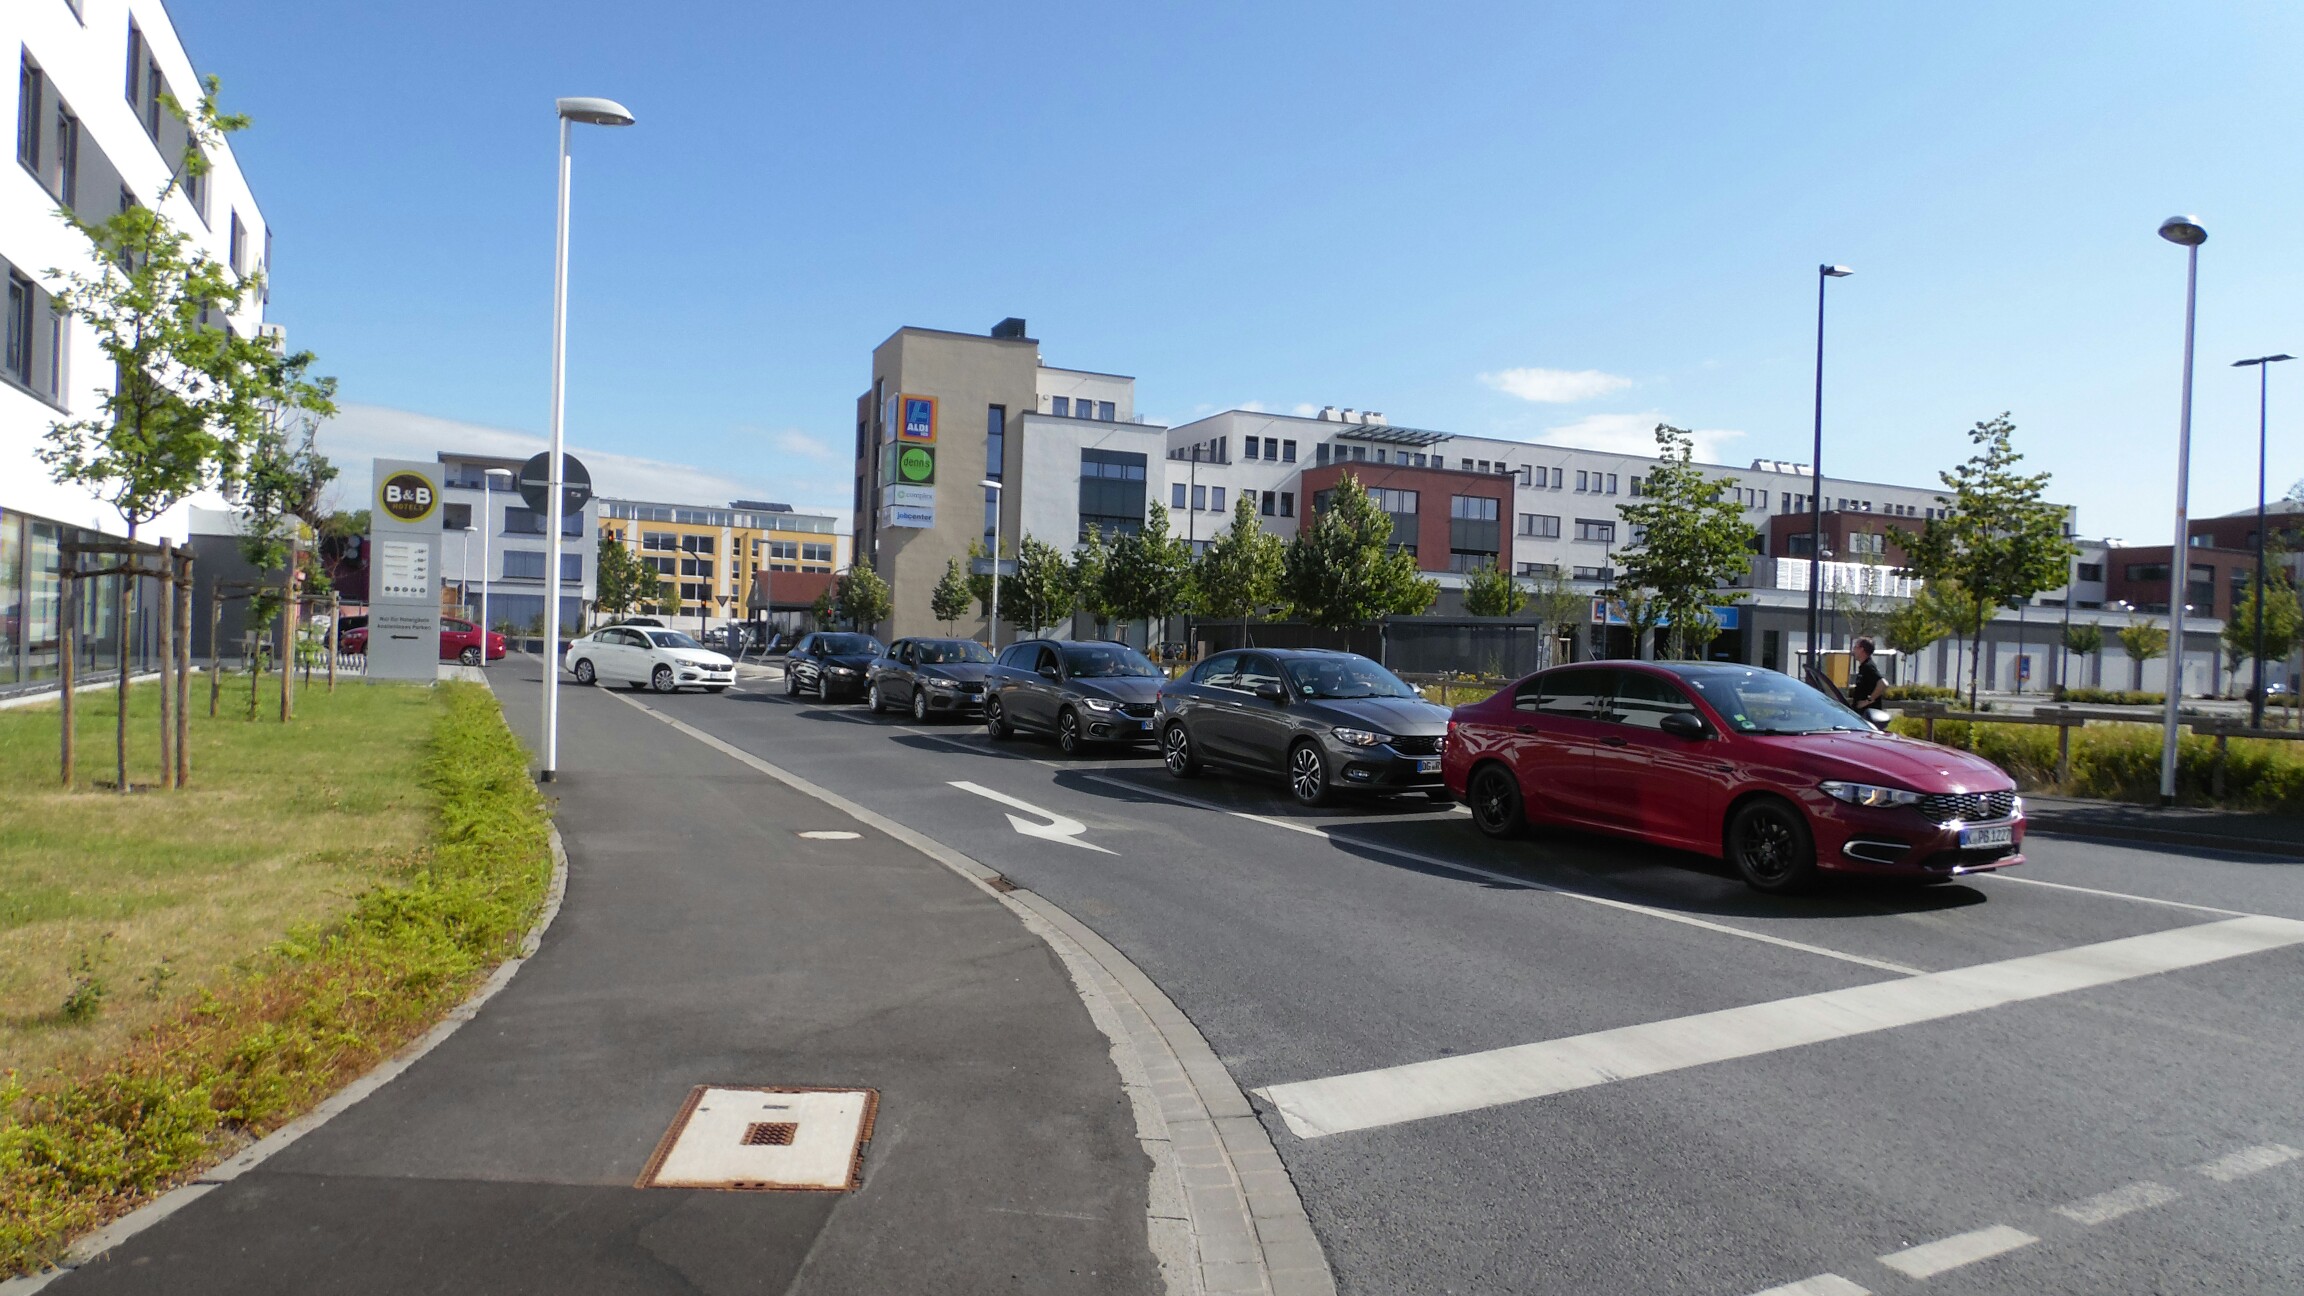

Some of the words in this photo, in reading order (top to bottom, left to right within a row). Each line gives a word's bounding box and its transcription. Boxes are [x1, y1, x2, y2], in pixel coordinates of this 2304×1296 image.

[907, 423, 928, 432] ALDI
[386, 485, 431, 505] B&B
[392, 503, 424, 511] HOTELS
[897, 512, 932, 521] jobcenter
